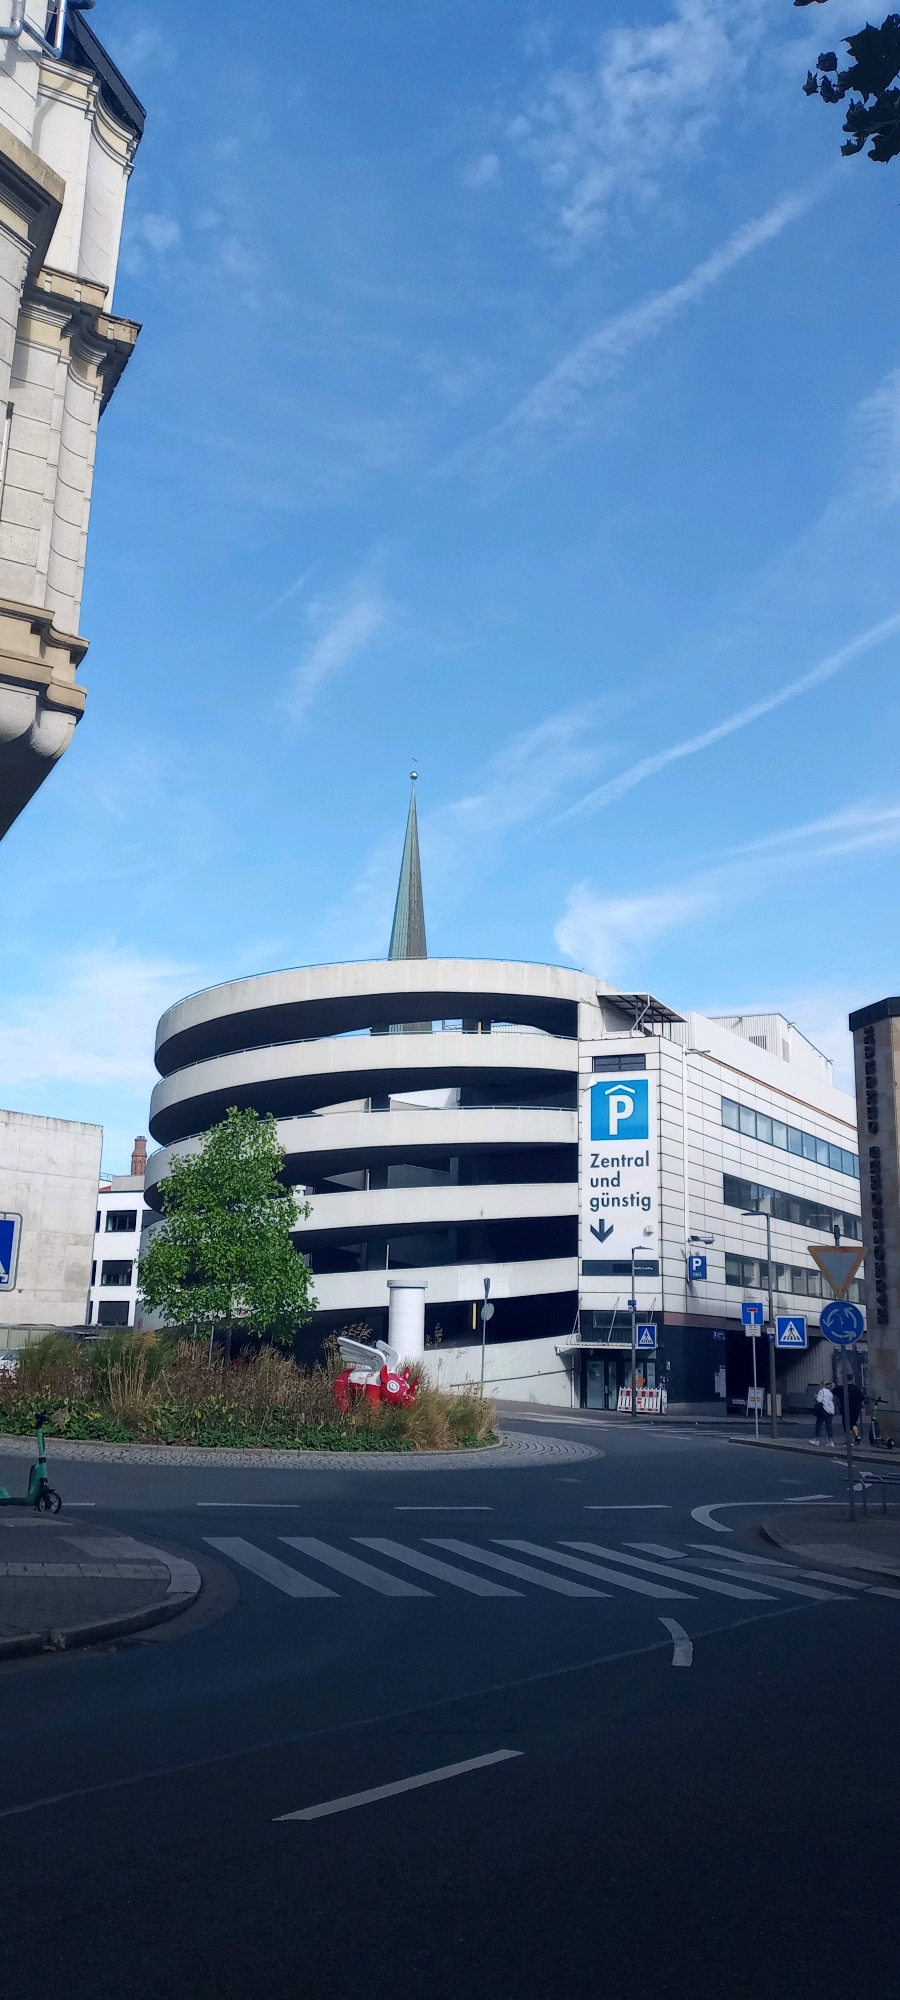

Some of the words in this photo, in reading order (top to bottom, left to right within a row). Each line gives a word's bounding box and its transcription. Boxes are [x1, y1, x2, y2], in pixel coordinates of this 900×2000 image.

[609, 1094, 635, 1136] P
[590, 1150, 649, 1168] Zentral
[590, 1170, 620, 1188] und
[590, 1191, 651, 1212] günstig
[692, 1258, 702, 1270] P
